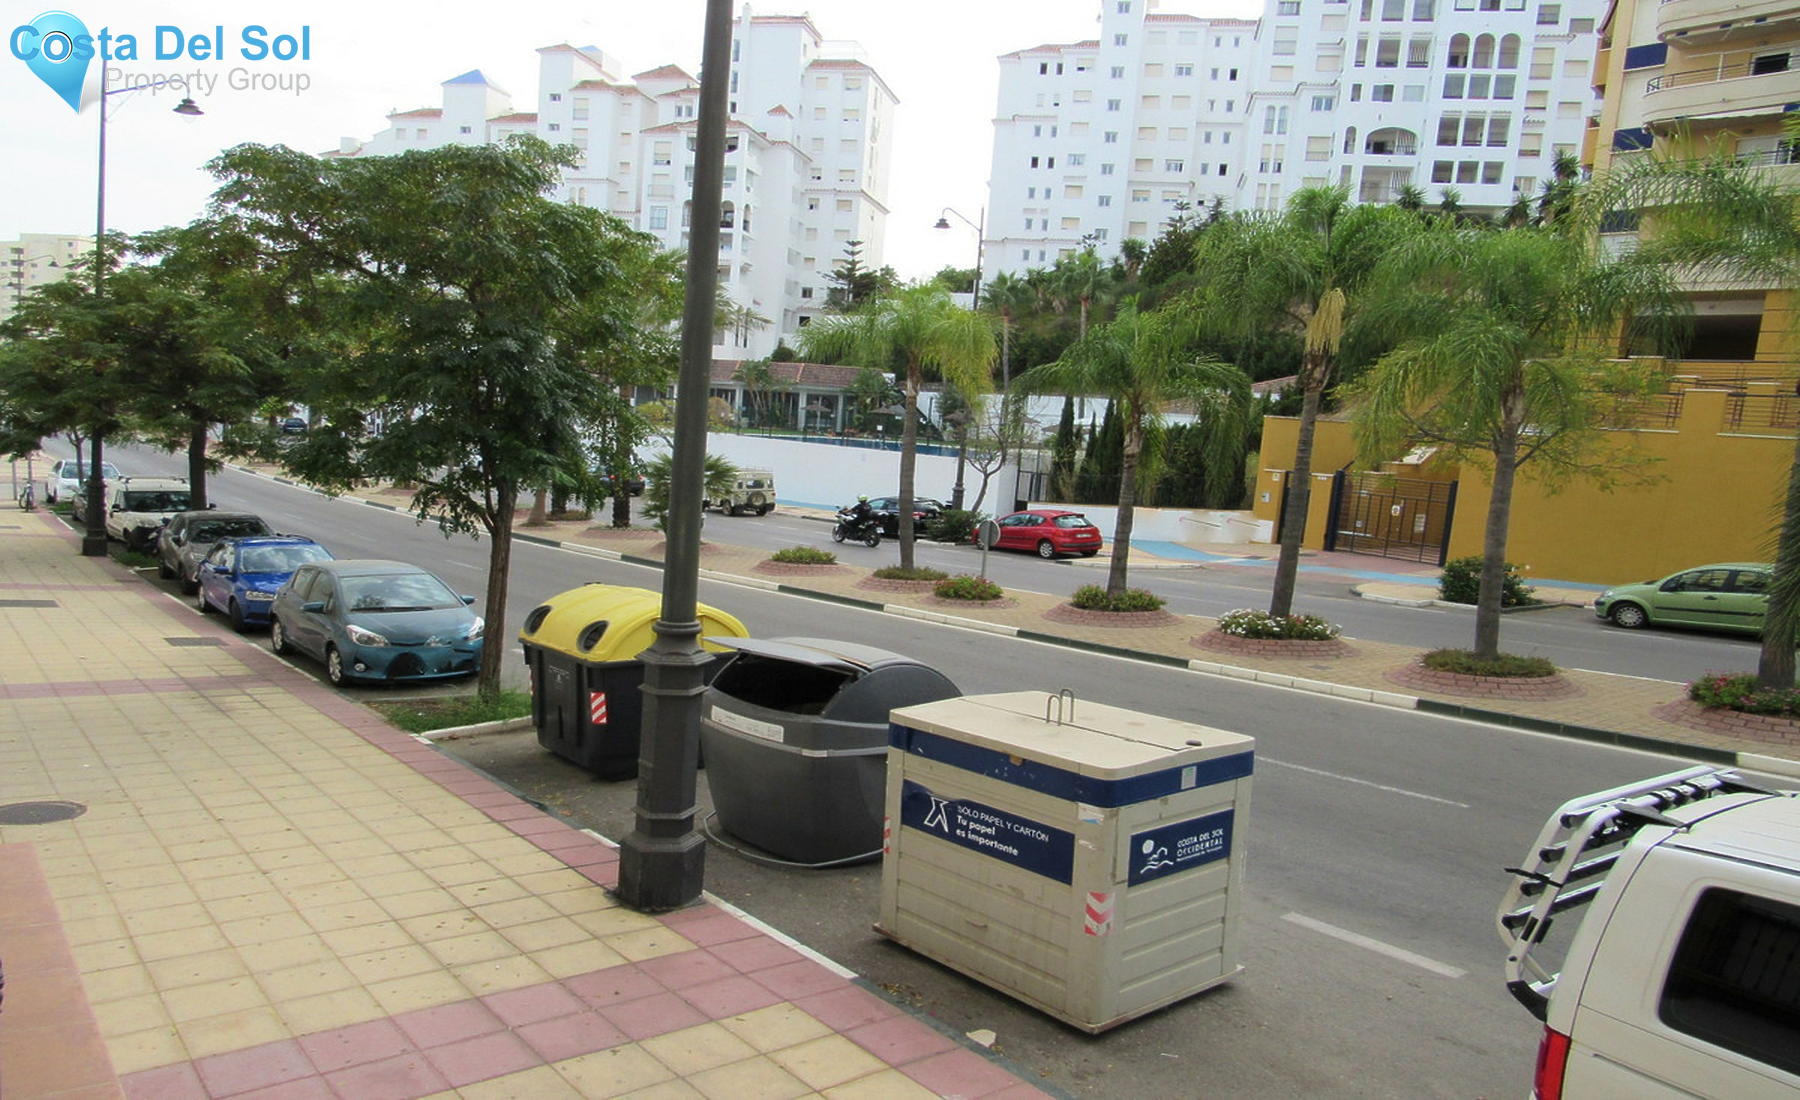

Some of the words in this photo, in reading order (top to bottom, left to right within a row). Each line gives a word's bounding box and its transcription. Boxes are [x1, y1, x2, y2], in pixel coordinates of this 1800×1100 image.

[957, 815, 967, 826] Tu
[969, 821, 996, 836] papel
[980, 812, 1005, 828] PAPEL
[1006, 821, 1013, 830] Y
[956, 829, 966, 838] es
[967, 831, 1019, 856] importante
[1177, 836, 1197, 848] COSTA
